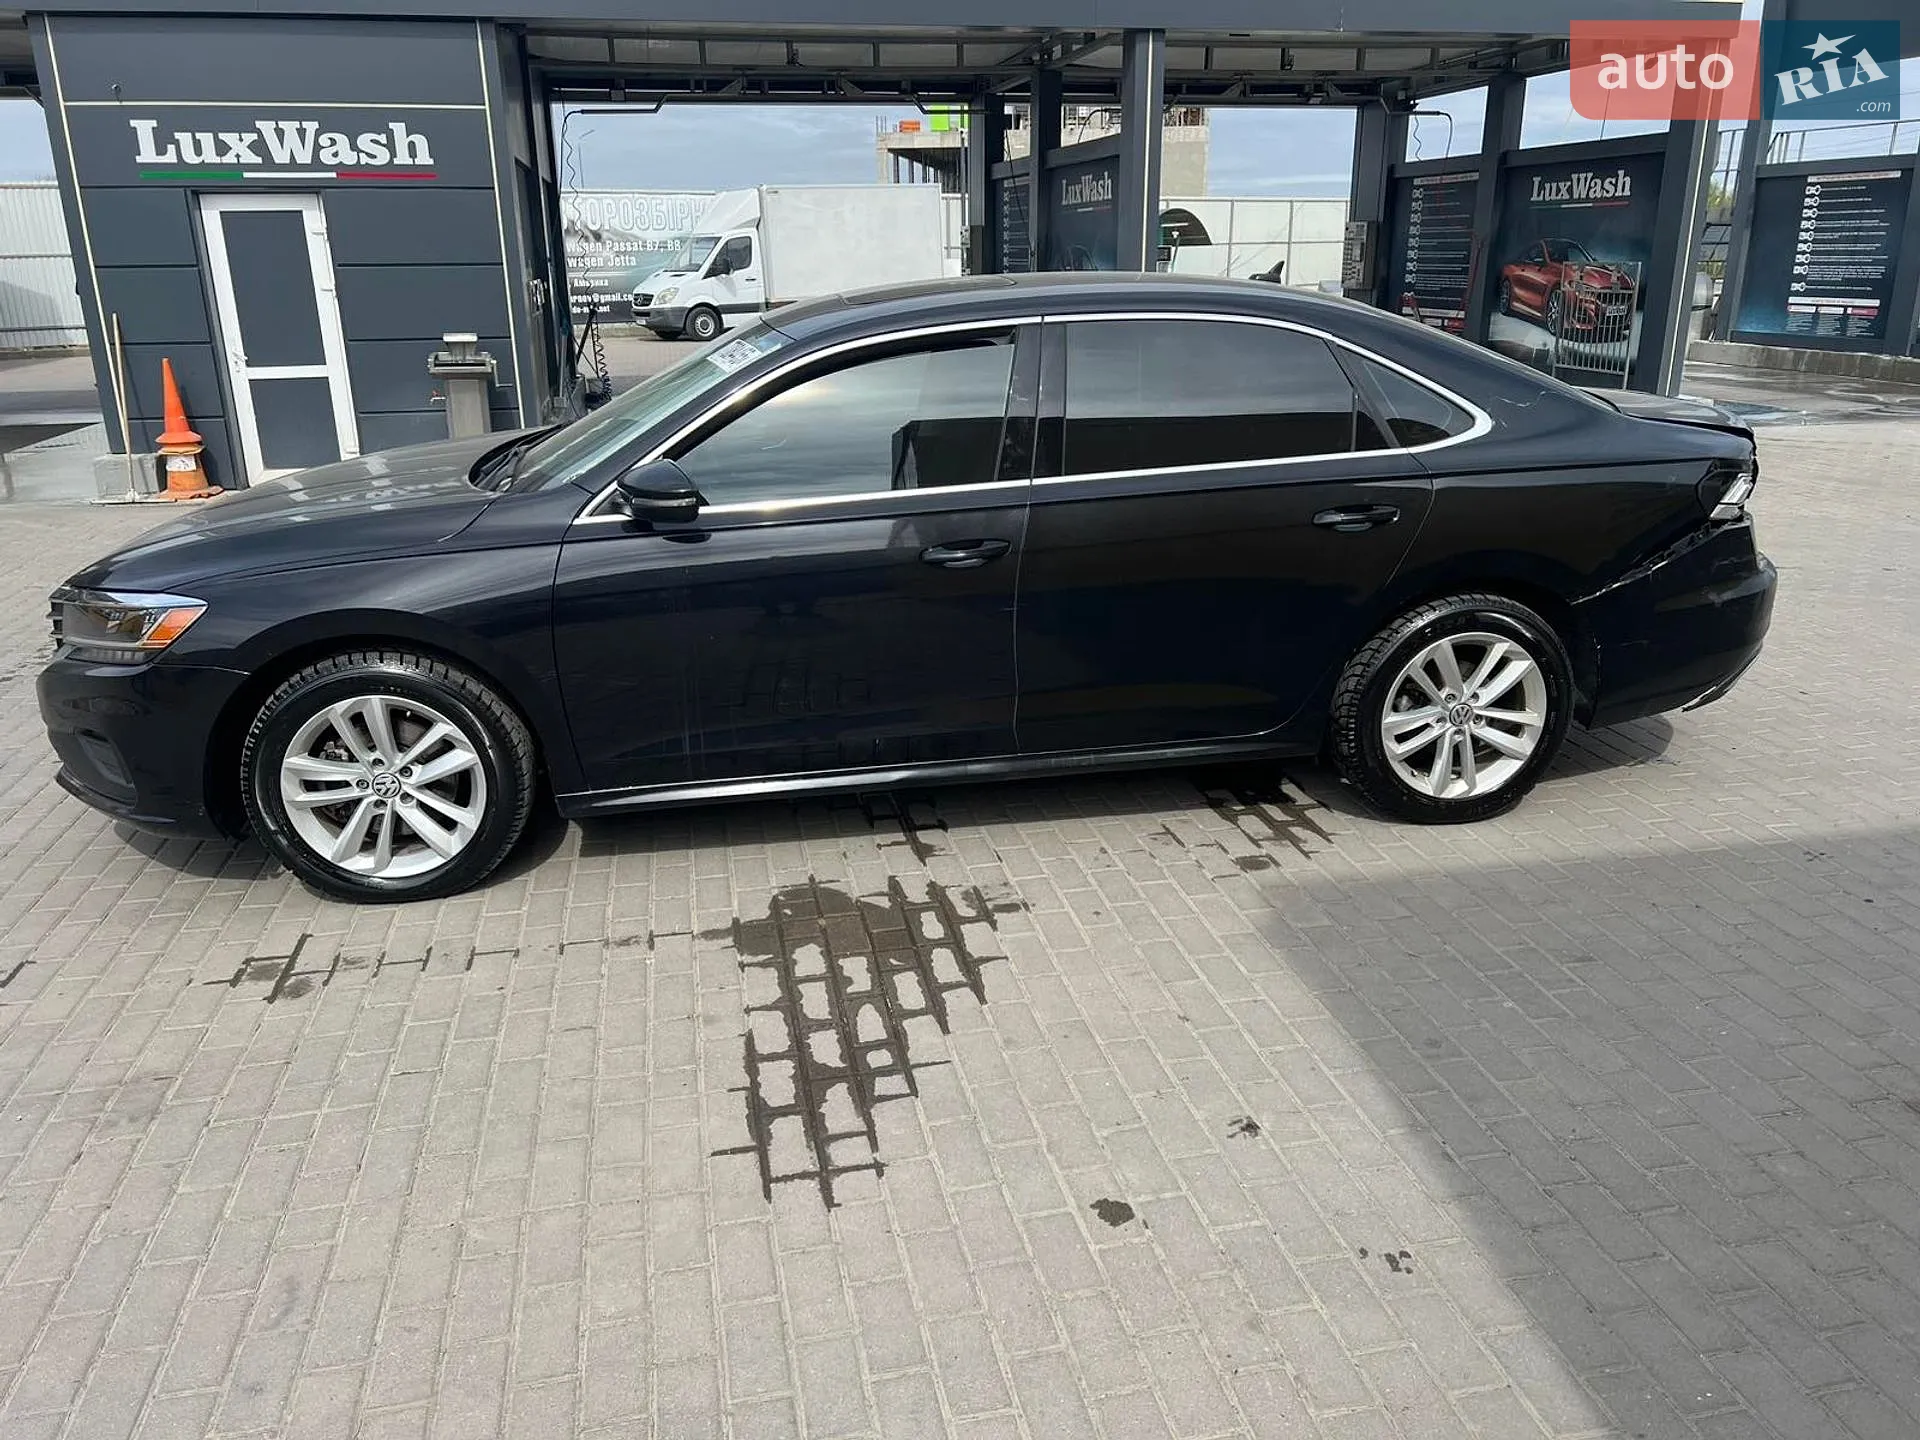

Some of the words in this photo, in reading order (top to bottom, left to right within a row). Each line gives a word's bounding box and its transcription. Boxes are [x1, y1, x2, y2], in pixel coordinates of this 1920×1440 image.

[129, 119, 434, 166] LuxWash
[1062, 171, 1112, 205] LuxWash
[1531, 169, 1631, 201] LuxWash
[606, 240, 644, 251] Passat
[607, 255, 637, 267] Jetta
